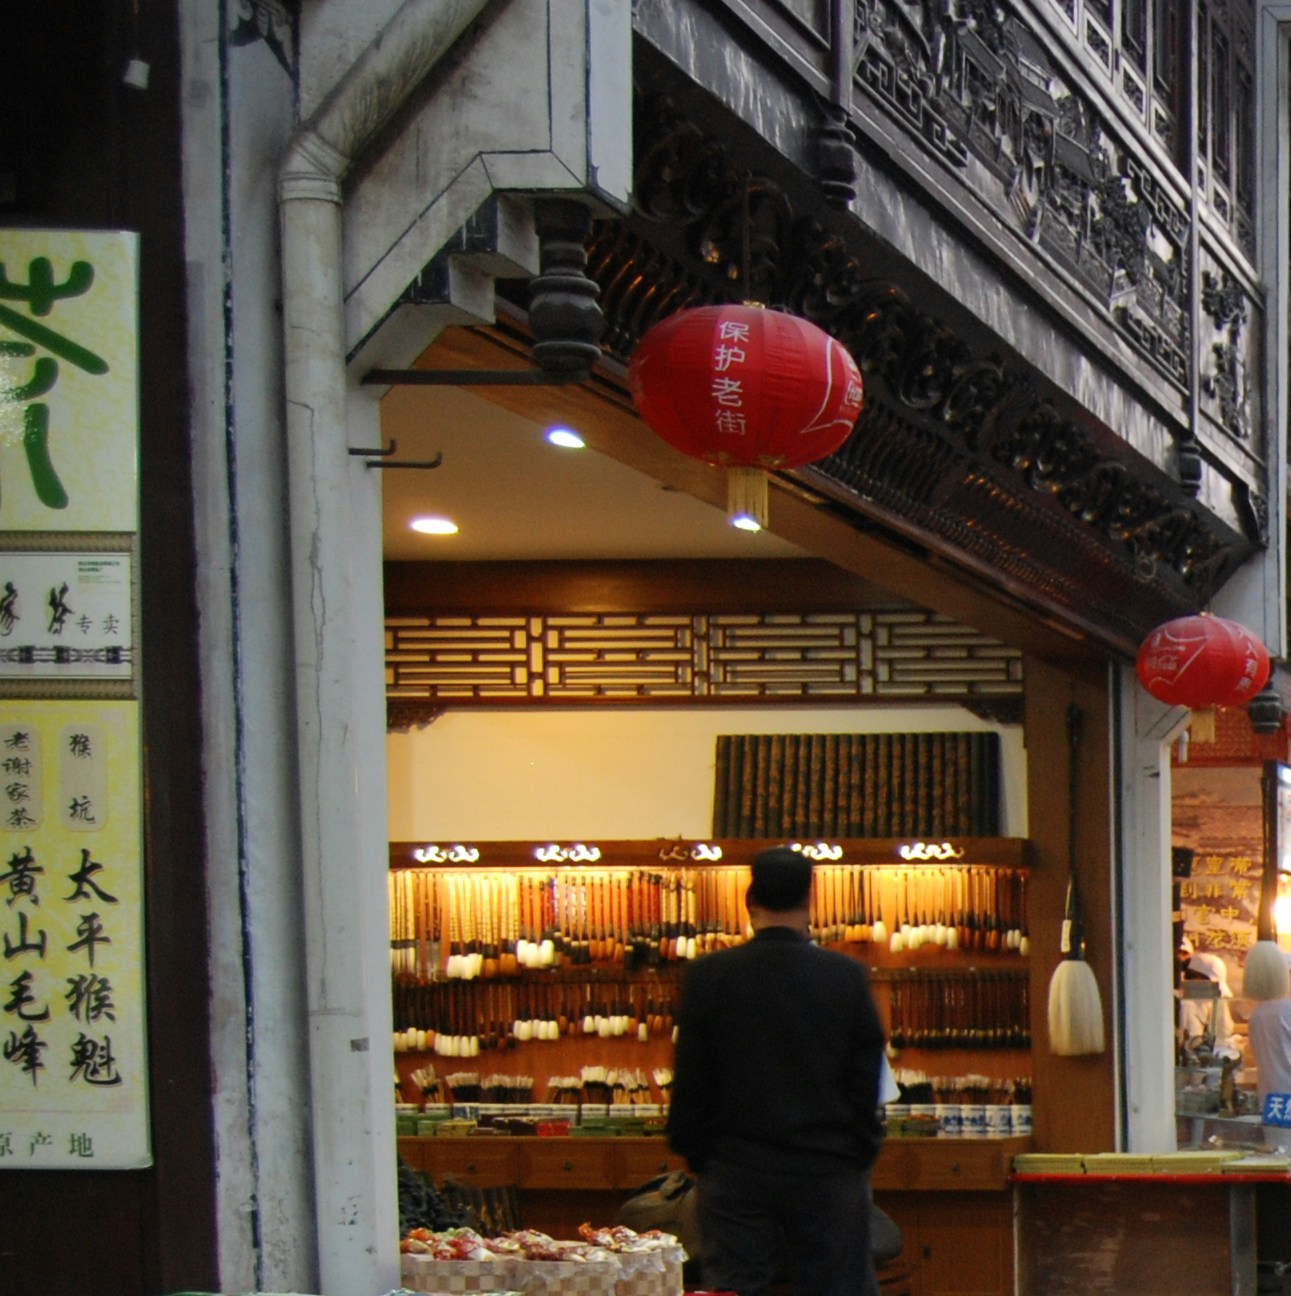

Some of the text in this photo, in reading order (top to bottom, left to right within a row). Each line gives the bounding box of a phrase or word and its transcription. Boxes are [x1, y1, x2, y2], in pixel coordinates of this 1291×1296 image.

[711, 320, 750, 436] 保护老街
[2, 732, 36, 828] 老谢家茶
[68, 732, 96, 825] 猴坑
[0, 846, 52, 1087] 黄山毛峰
[64, 848, 122, 1087] 太平猴魁
